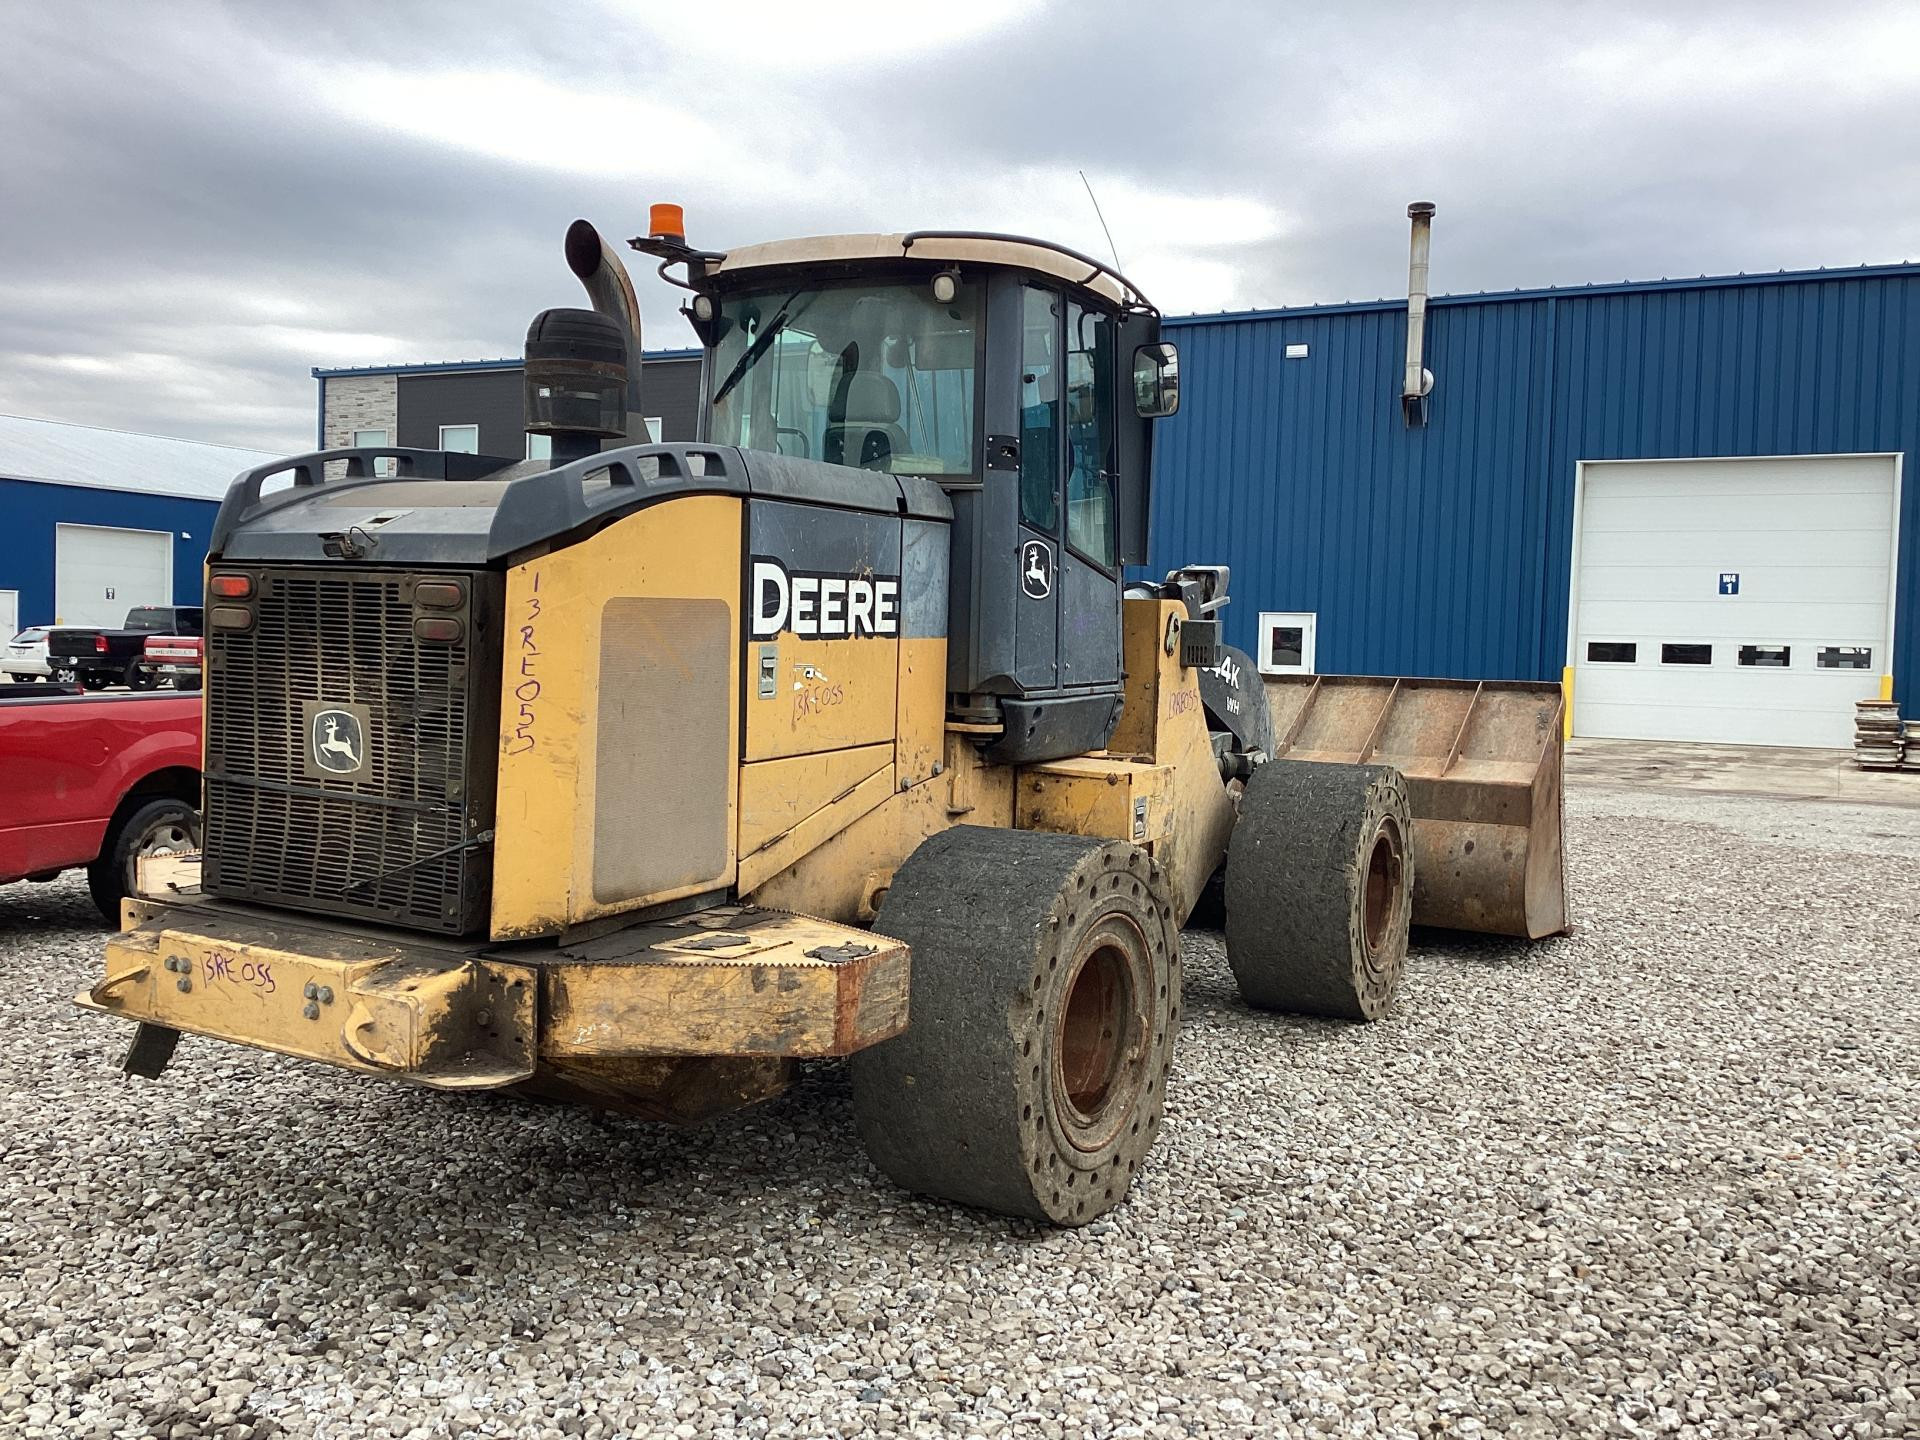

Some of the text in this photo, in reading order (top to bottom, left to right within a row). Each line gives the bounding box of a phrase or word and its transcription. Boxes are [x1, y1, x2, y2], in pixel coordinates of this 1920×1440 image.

[753, 562, 897, 635] DEERE
[1726, 583, 1733, 594] 1
[1201, 655, 1241, 690] 4K
[1226, 696, 1240, 716] WH
